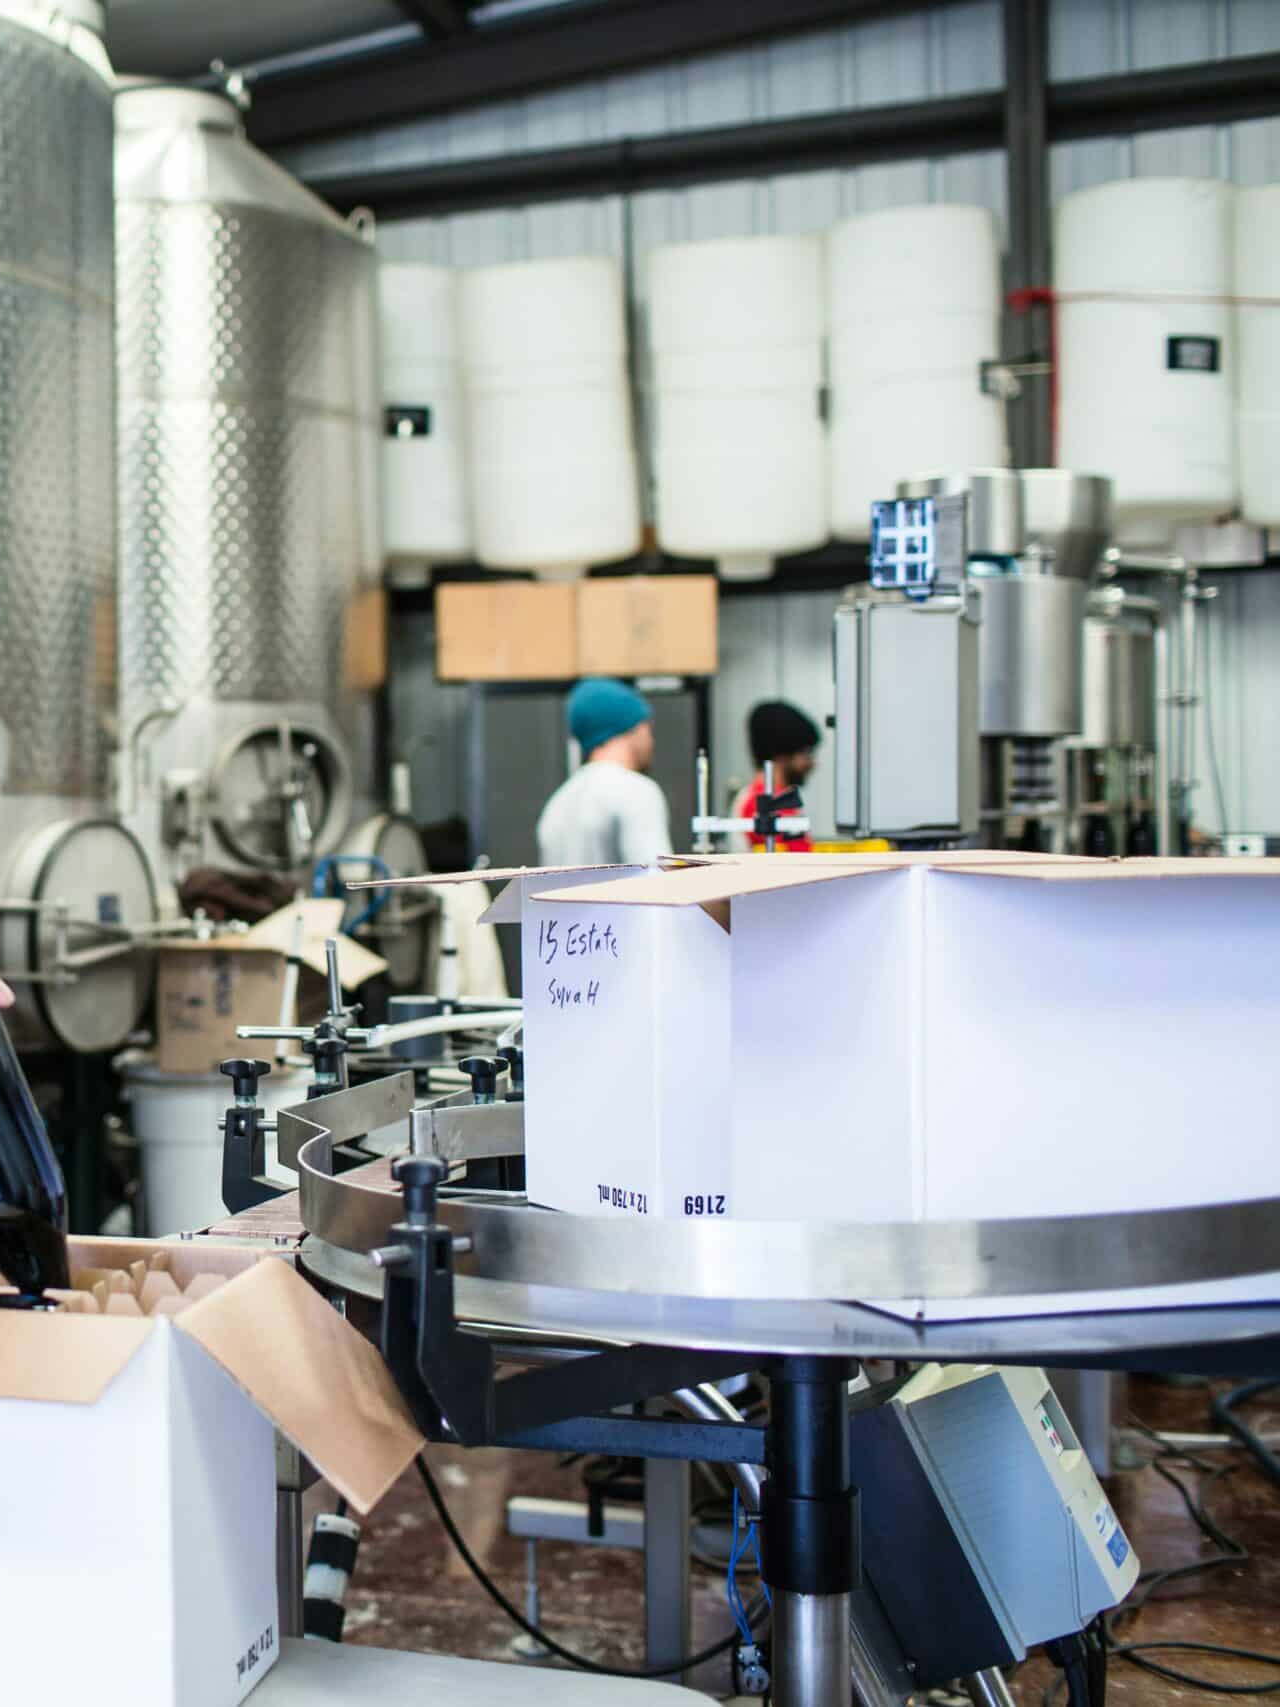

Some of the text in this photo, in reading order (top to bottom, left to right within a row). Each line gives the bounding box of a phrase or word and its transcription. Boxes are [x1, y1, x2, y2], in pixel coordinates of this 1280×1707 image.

[538, 919, 618, 965] 15 Estate
[612, 1187, 628, 1209] 750
[637, 1193, 648, 1214] 12
[684, 1195, 726, 1216] 2169
